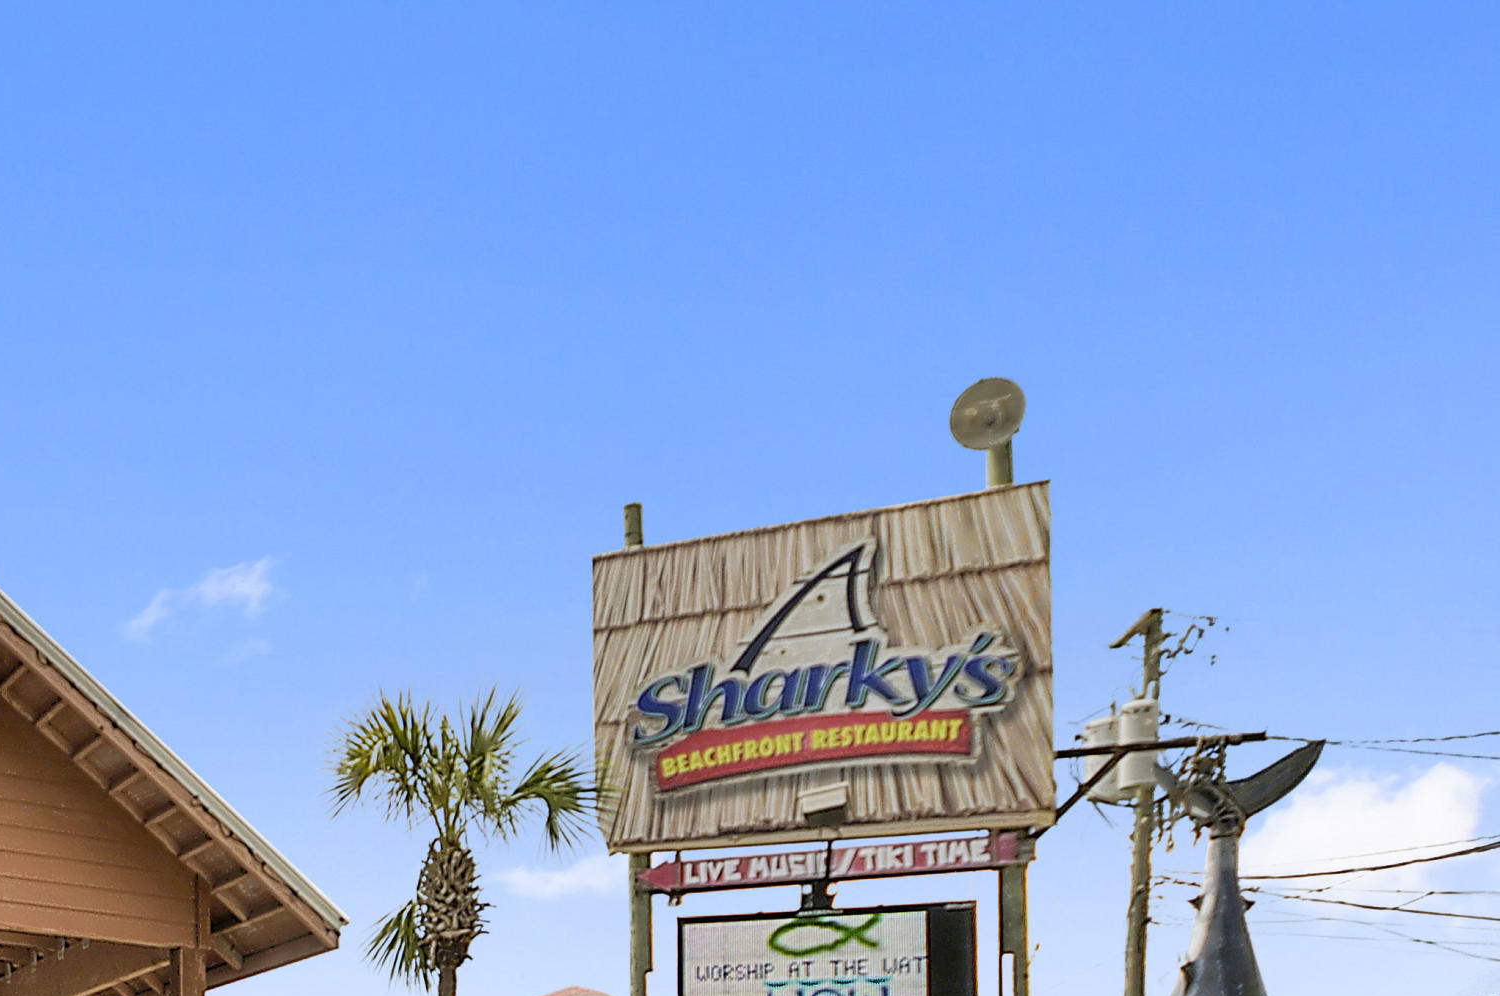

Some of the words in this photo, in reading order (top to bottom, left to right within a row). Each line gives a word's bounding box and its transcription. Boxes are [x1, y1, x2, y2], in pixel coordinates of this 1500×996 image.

[634, 632, 1013, 745] Sharky's
[661, 731, 803, 779] BEACHFRONT
[810, 718, 964, 751] RESTAURANT
[684, 859, 742, 885] LIVE
[920, 838, 991, 867] TIME
[696, 961, 775, 983] WORSHIP
[788, 960, 814, 978] AT
[829, 958, 869, 977] THE
